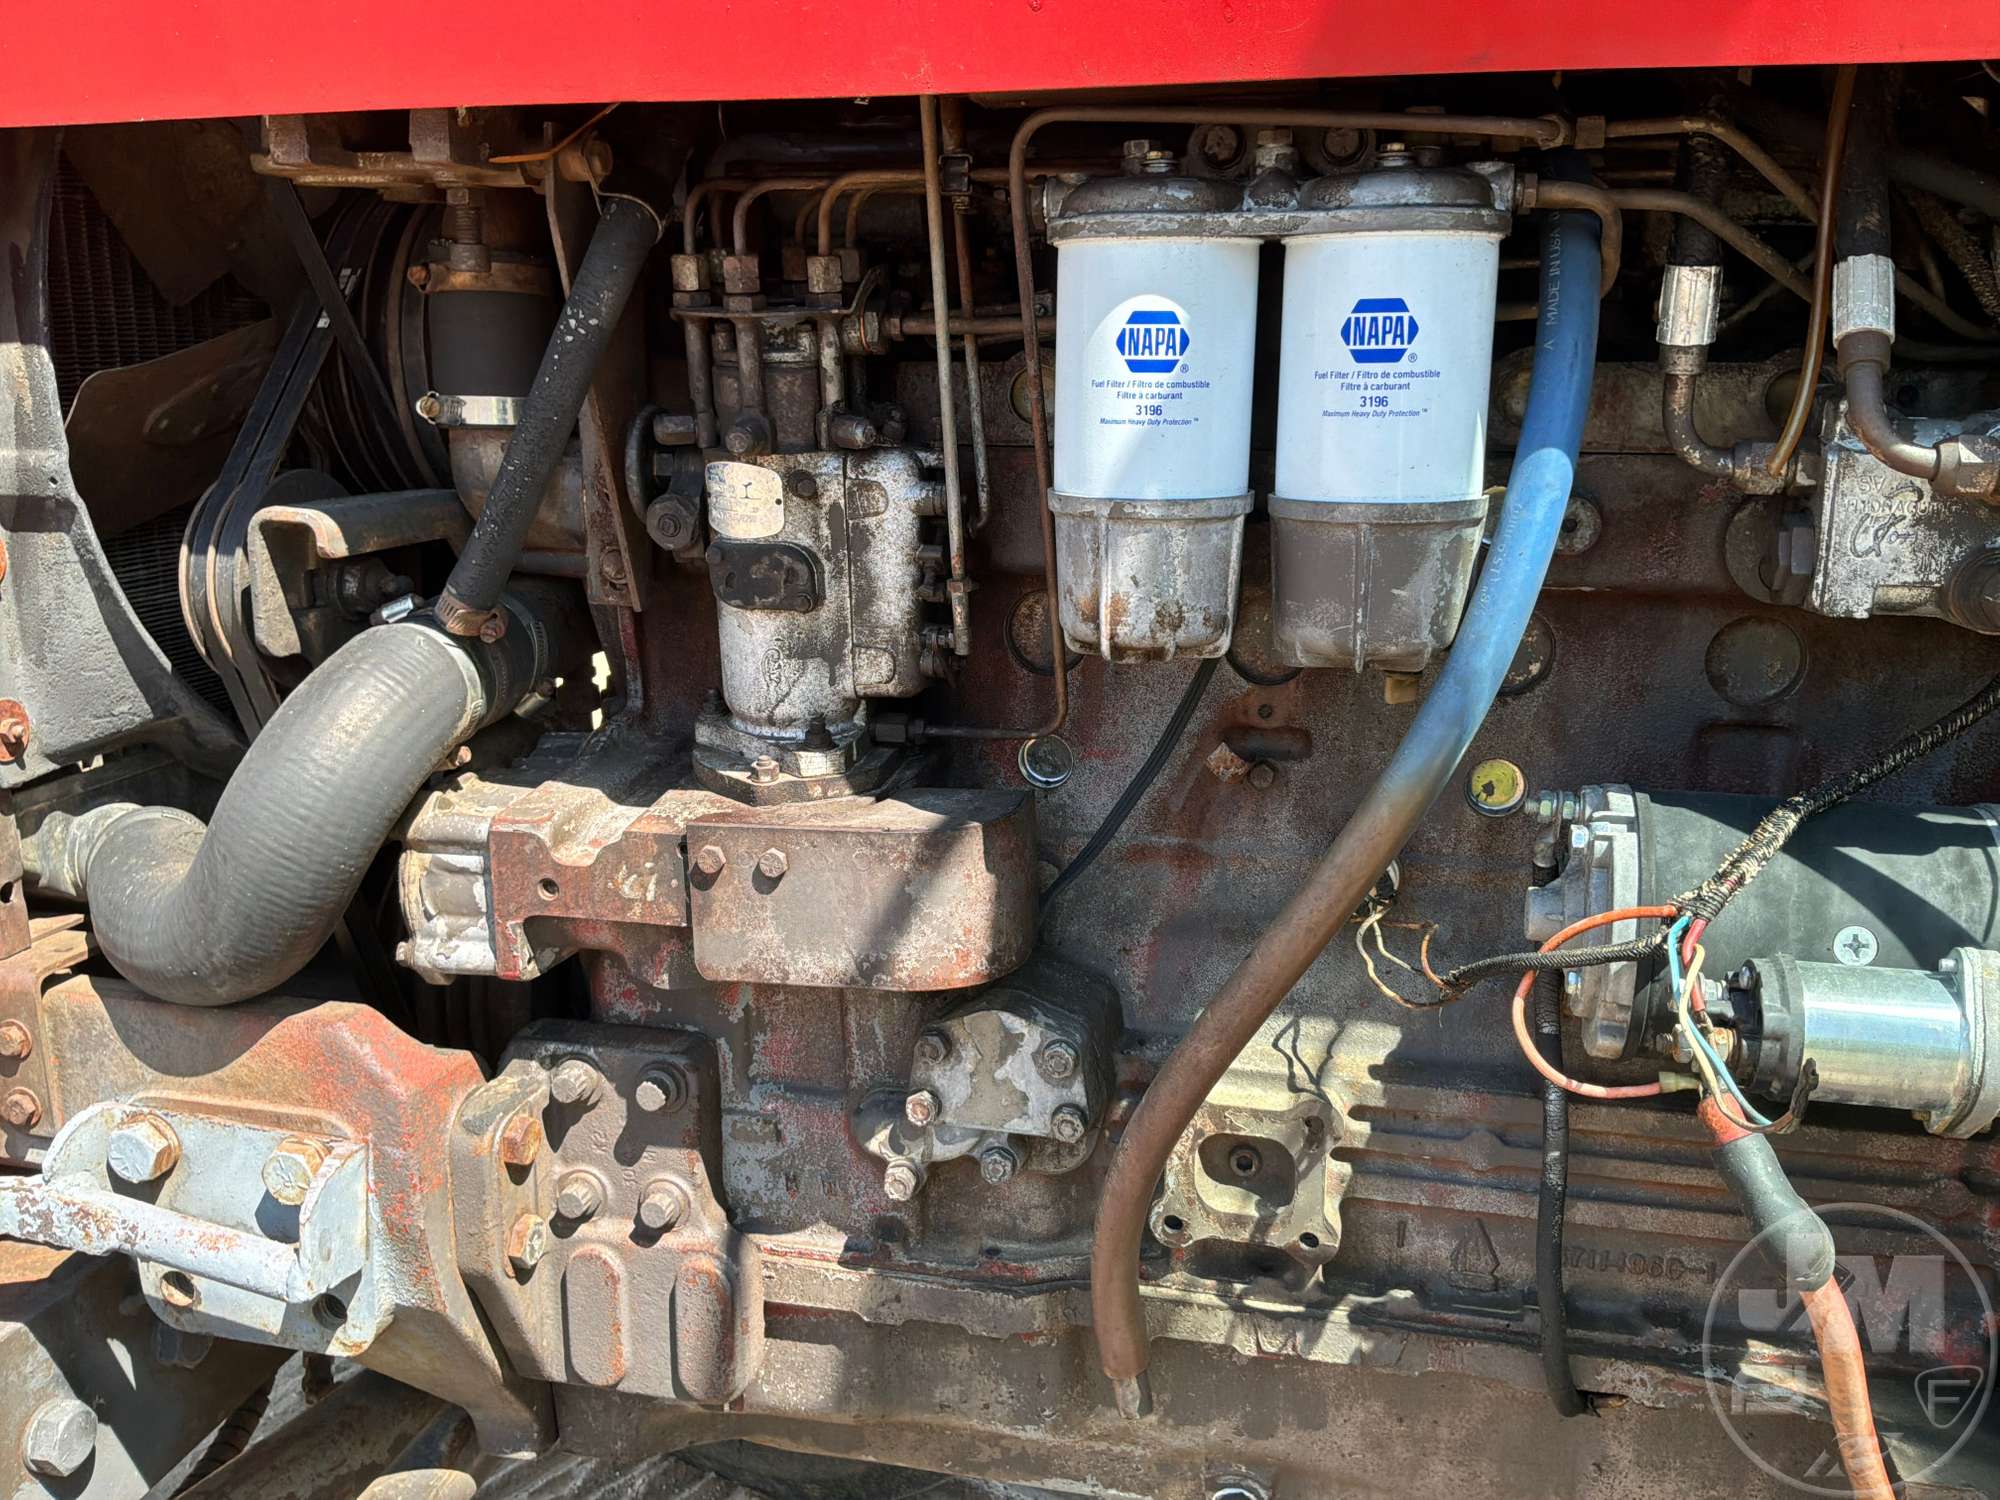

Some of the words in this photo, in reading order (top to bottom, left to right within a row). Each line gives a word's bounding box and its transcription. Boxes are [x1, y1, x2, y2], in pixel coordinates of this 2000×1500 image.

[1550, 228, 1561, 258] USA
[1549, 260, 1561, 276] IN
[1545, 281, 1560, 325] MADE
[1353, 315, 1405, 346] NAPA
[1128, 327, 1177, 356] NAPA
[1314, 371, 1328, 380] Fuel
[1330, 371, 1349, 379] Filter
[1357, 370, 1378, 379] Filtro
[1380, 370, 1391, 379] de
[1392, 369, 1441, 379] combustible
[1091, 379, 1105, 389] Fuel
[1106, 379, 1125, 388] Filter
[1132, 379, 1152, 388] Filtro
[1154, 379, 1165, 388] de
[1166, 379, 1211, 388] combustible
[1340, 382, 1361, 391] Filtre
[1370, 382, 1411, 391] carburant
[1116, 391, 1137, 400] Filtre
[1145, 391, 1183, 400] carburant
[1360, 395, 1389, 408] 3196
[1136, 404, 1163, 416] 3196
[1351, 410, 1370, 419] Heavy
[1371, 409, 1386, 418] Duty
[1128, 418, 1146, 426] Heavy
[1147, 418, 1161, 426] Duty
